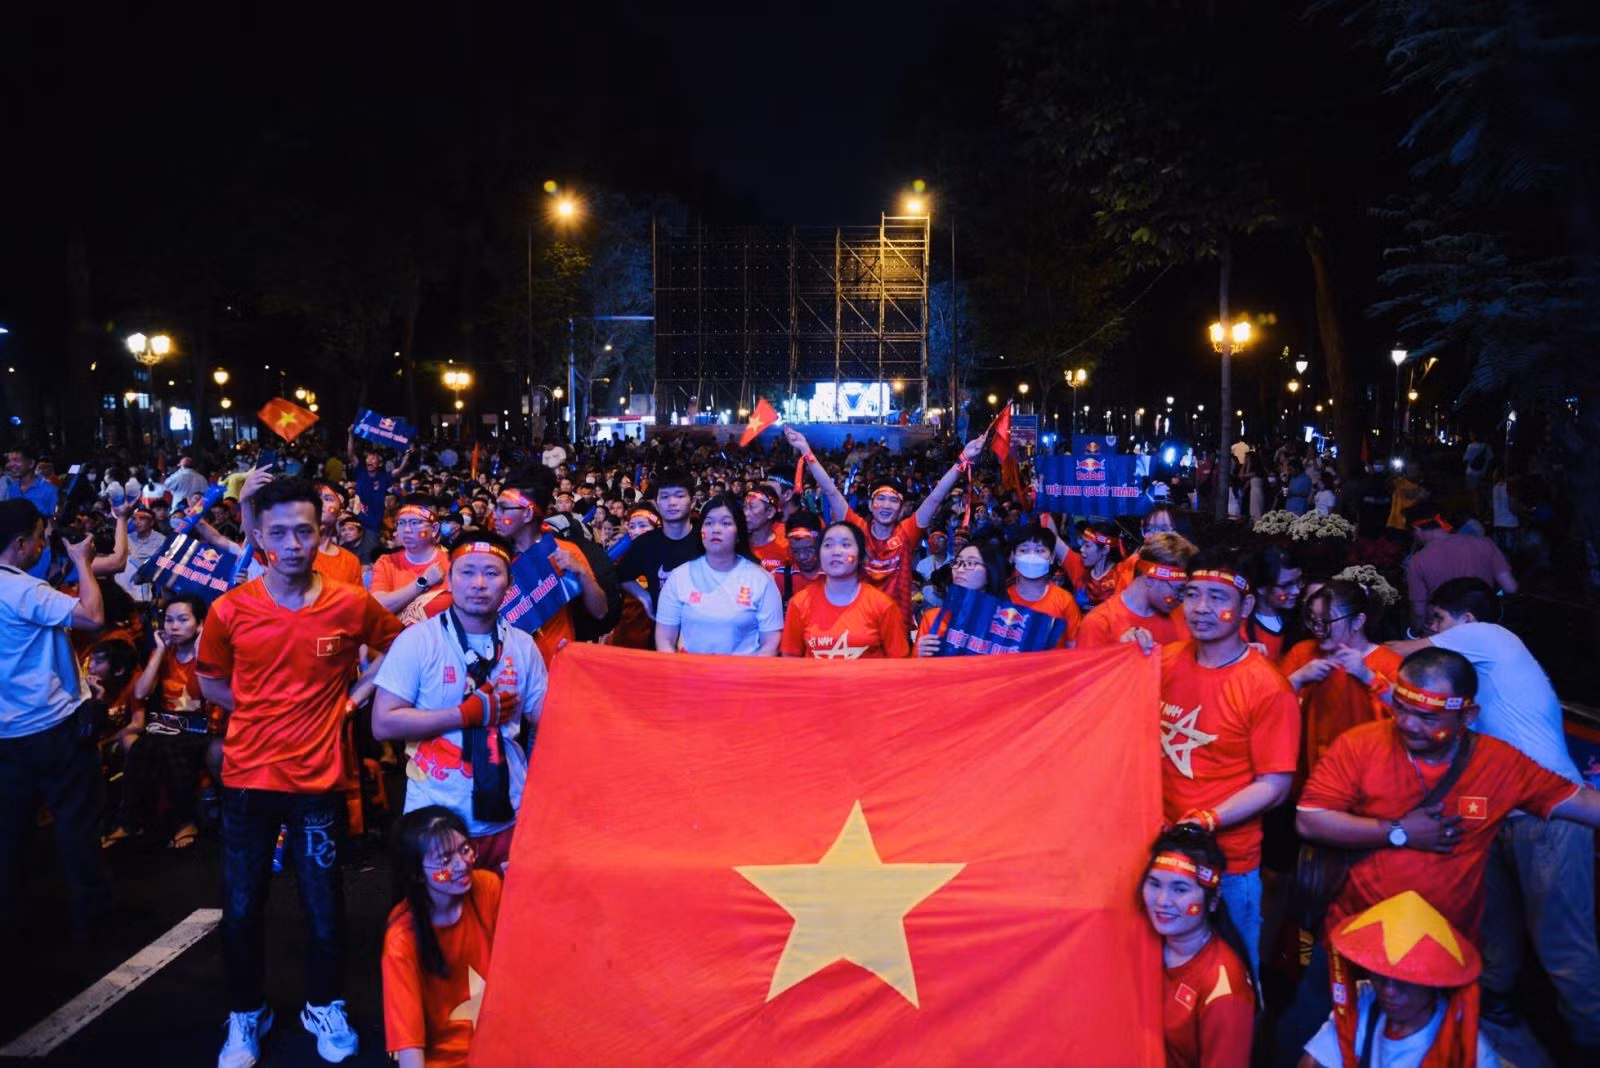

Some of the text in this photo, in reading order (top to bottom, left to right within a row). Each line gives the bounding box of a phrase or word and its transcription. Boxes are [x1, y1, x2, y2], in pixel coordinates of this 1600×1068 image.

[1045, 483, 1139, 497] VIỆT NAM QUYẾT THẮNG
[506, 573, 558, 624] QUYẾT THẮNG
[946, 628, 969, 649] VIỆT
[966, 635, 992, 655] NAM
